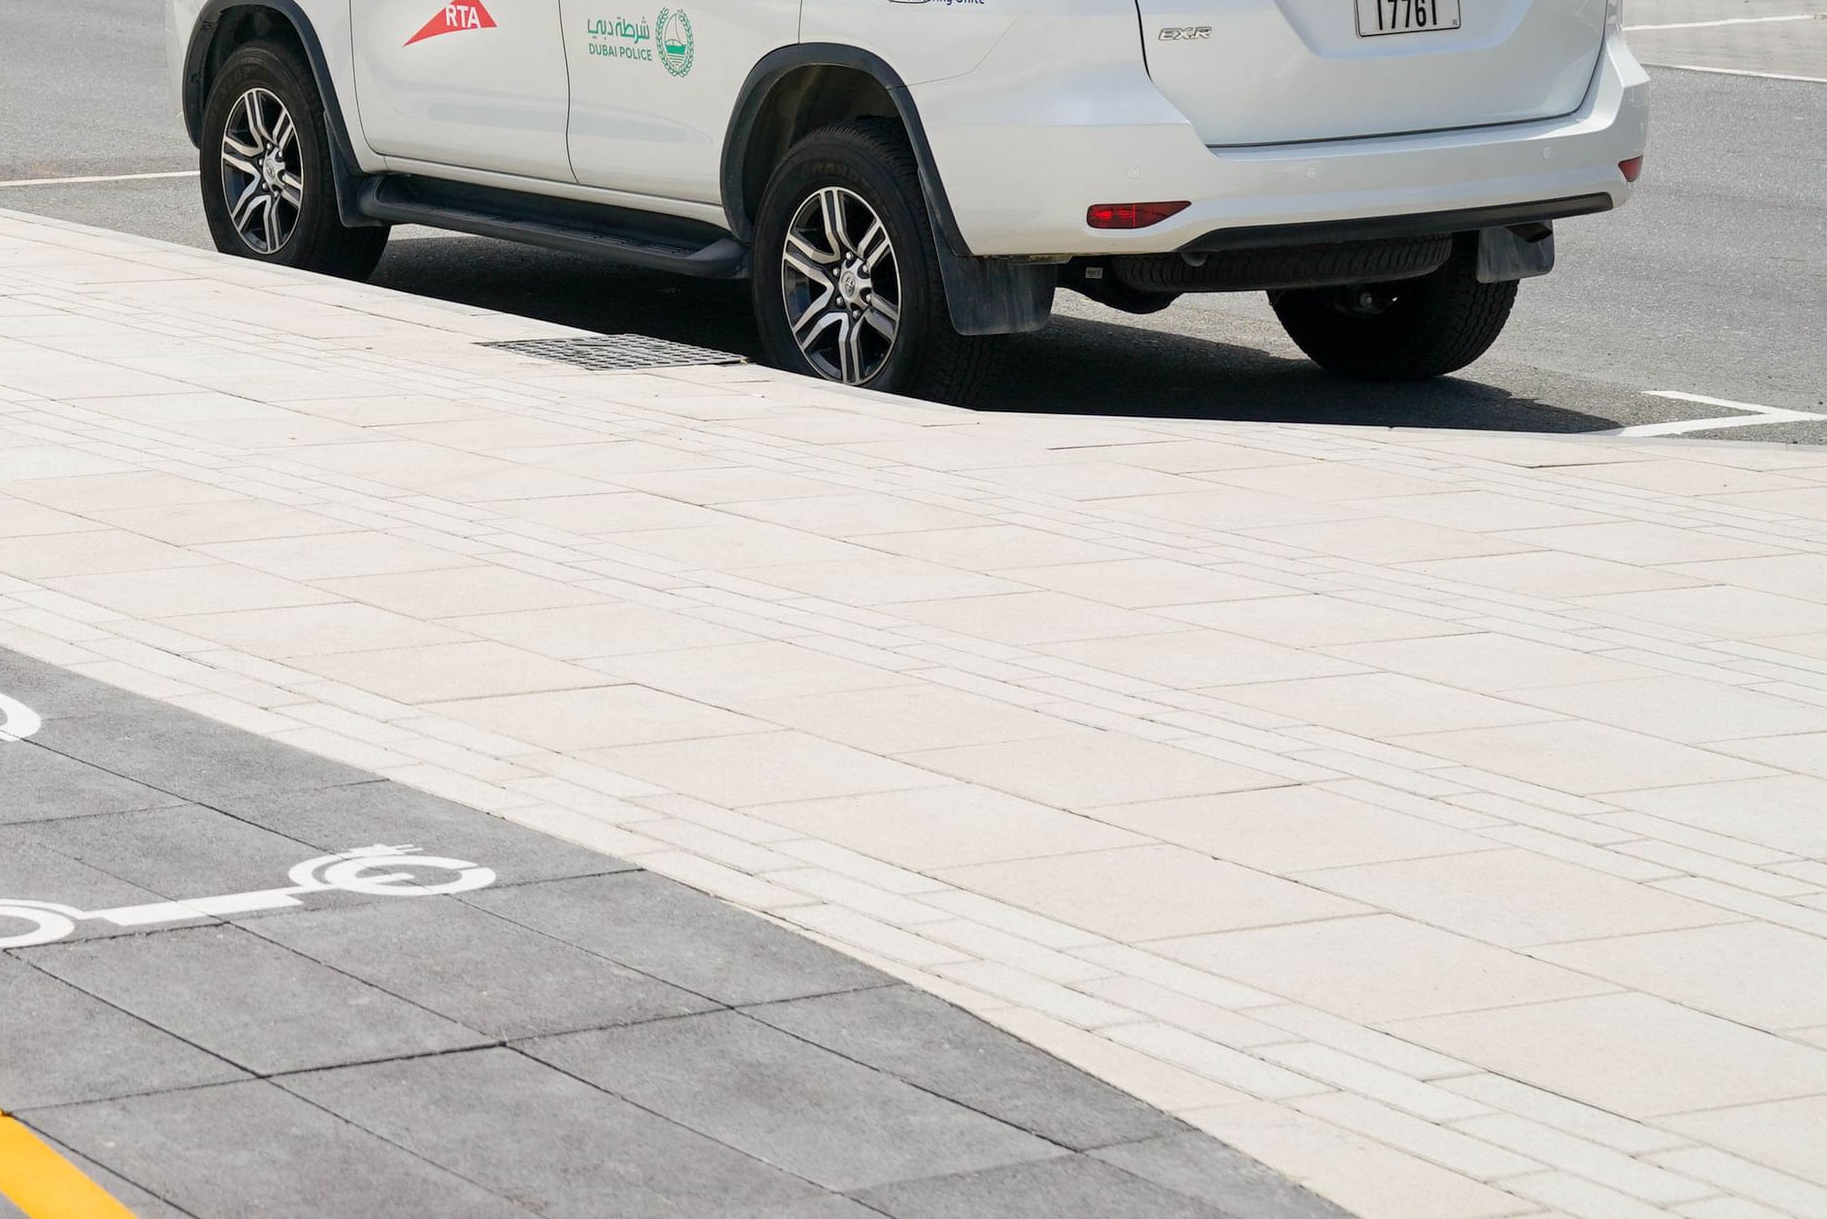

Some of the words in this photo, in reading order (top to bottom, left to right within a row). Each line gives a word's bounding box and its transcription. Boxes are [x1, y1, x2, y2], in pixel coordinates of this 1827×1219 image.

[445, 4, 482, 29] RTA
[587, 18, 614, 40] دبي
[615, 16, 650, 44] شرطة
[588, 42, 617, 57] DUBAI
[619, 46, 652, 61] POLICE
